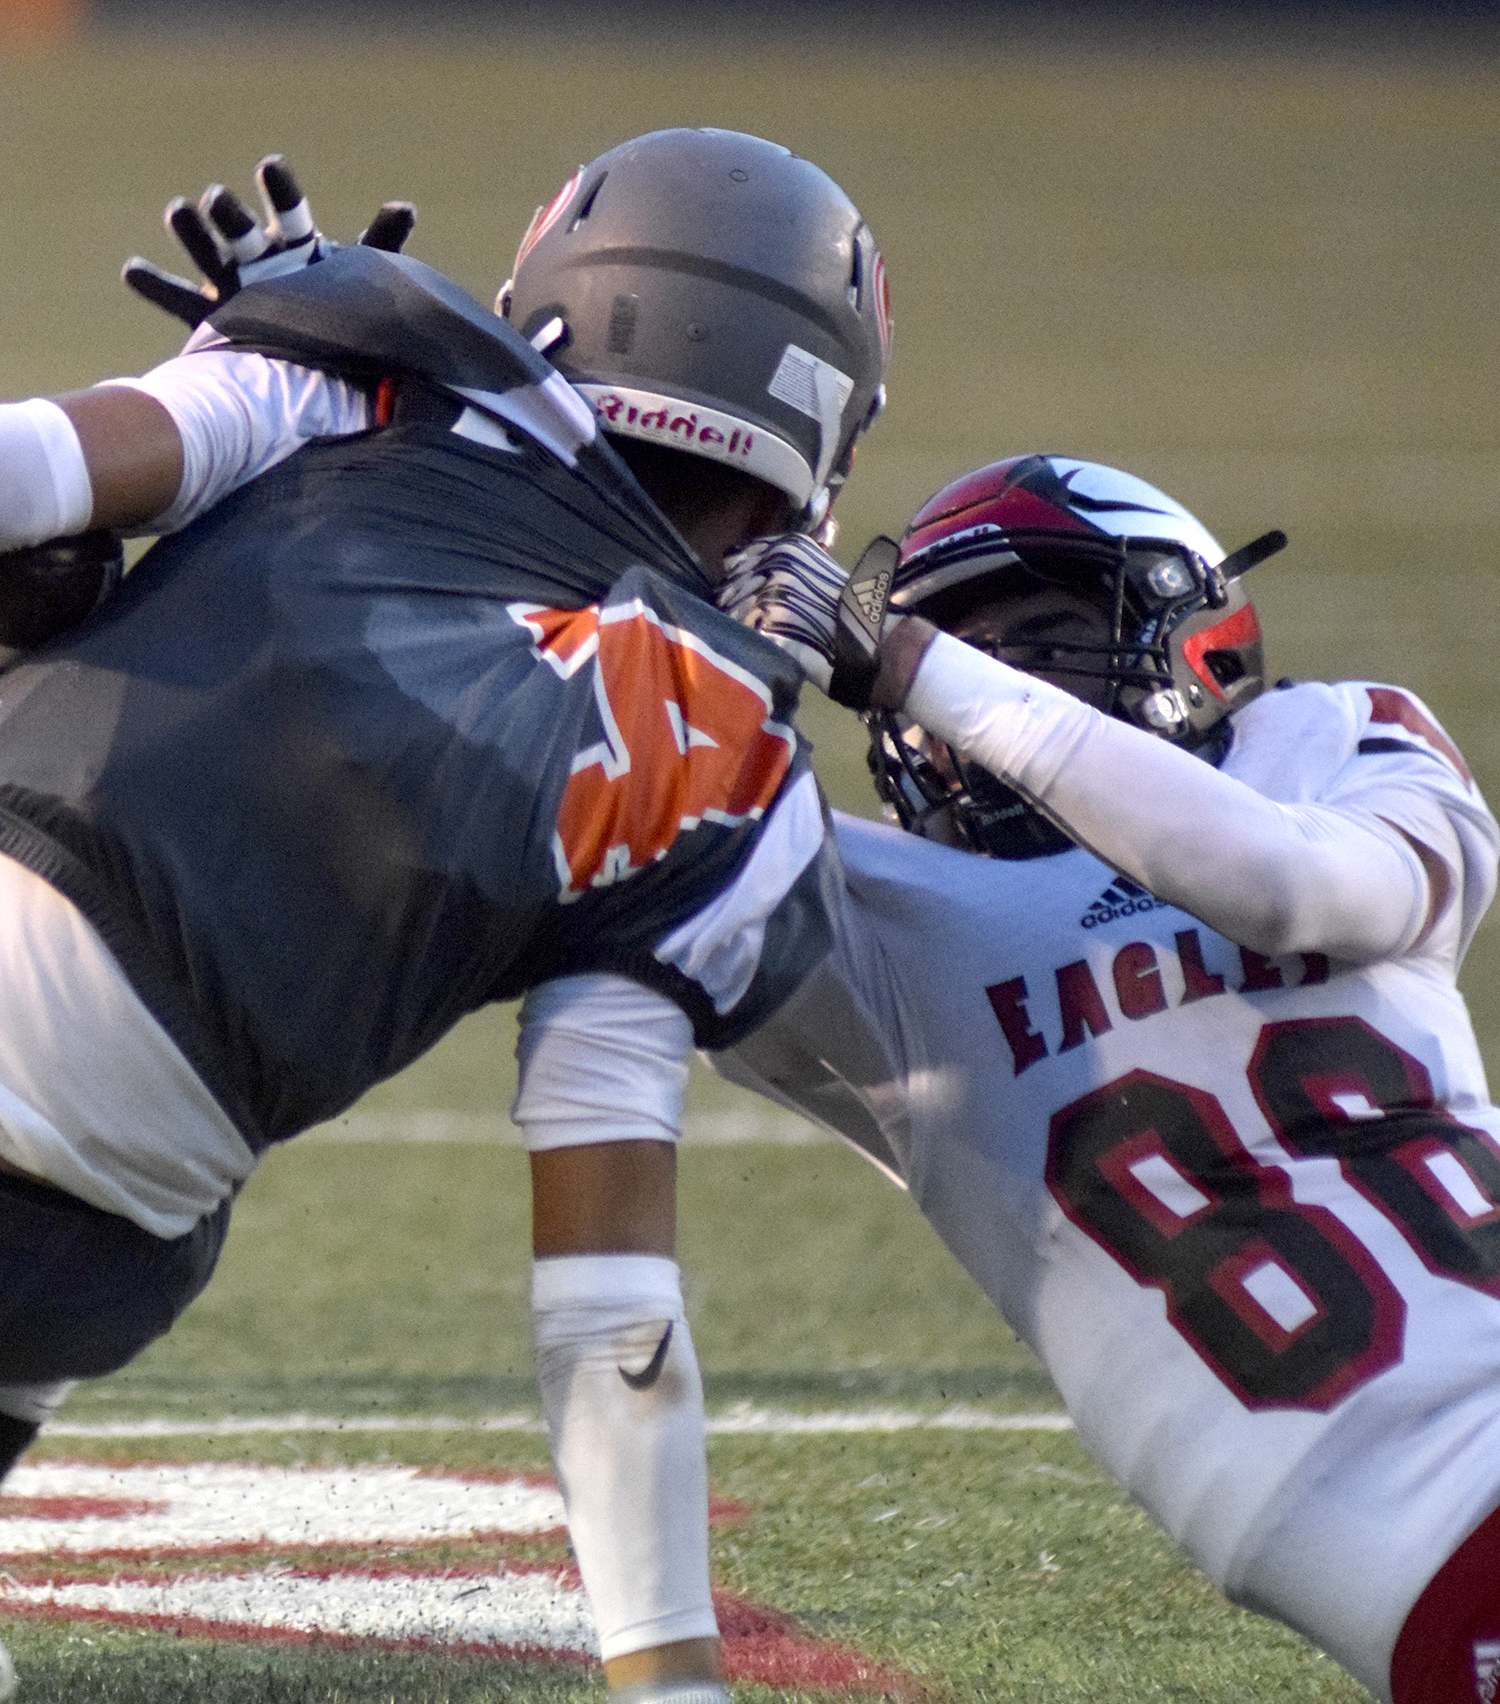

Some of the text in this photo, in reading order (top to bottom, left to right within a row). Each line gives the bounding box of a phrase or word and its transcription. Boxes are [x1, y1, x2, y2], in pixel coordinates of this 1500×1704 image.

[598, 394, 753, 456] Riddell
[870, 572, 890, 623] adidas
[1045, 1015, 1500, 1413] 88
